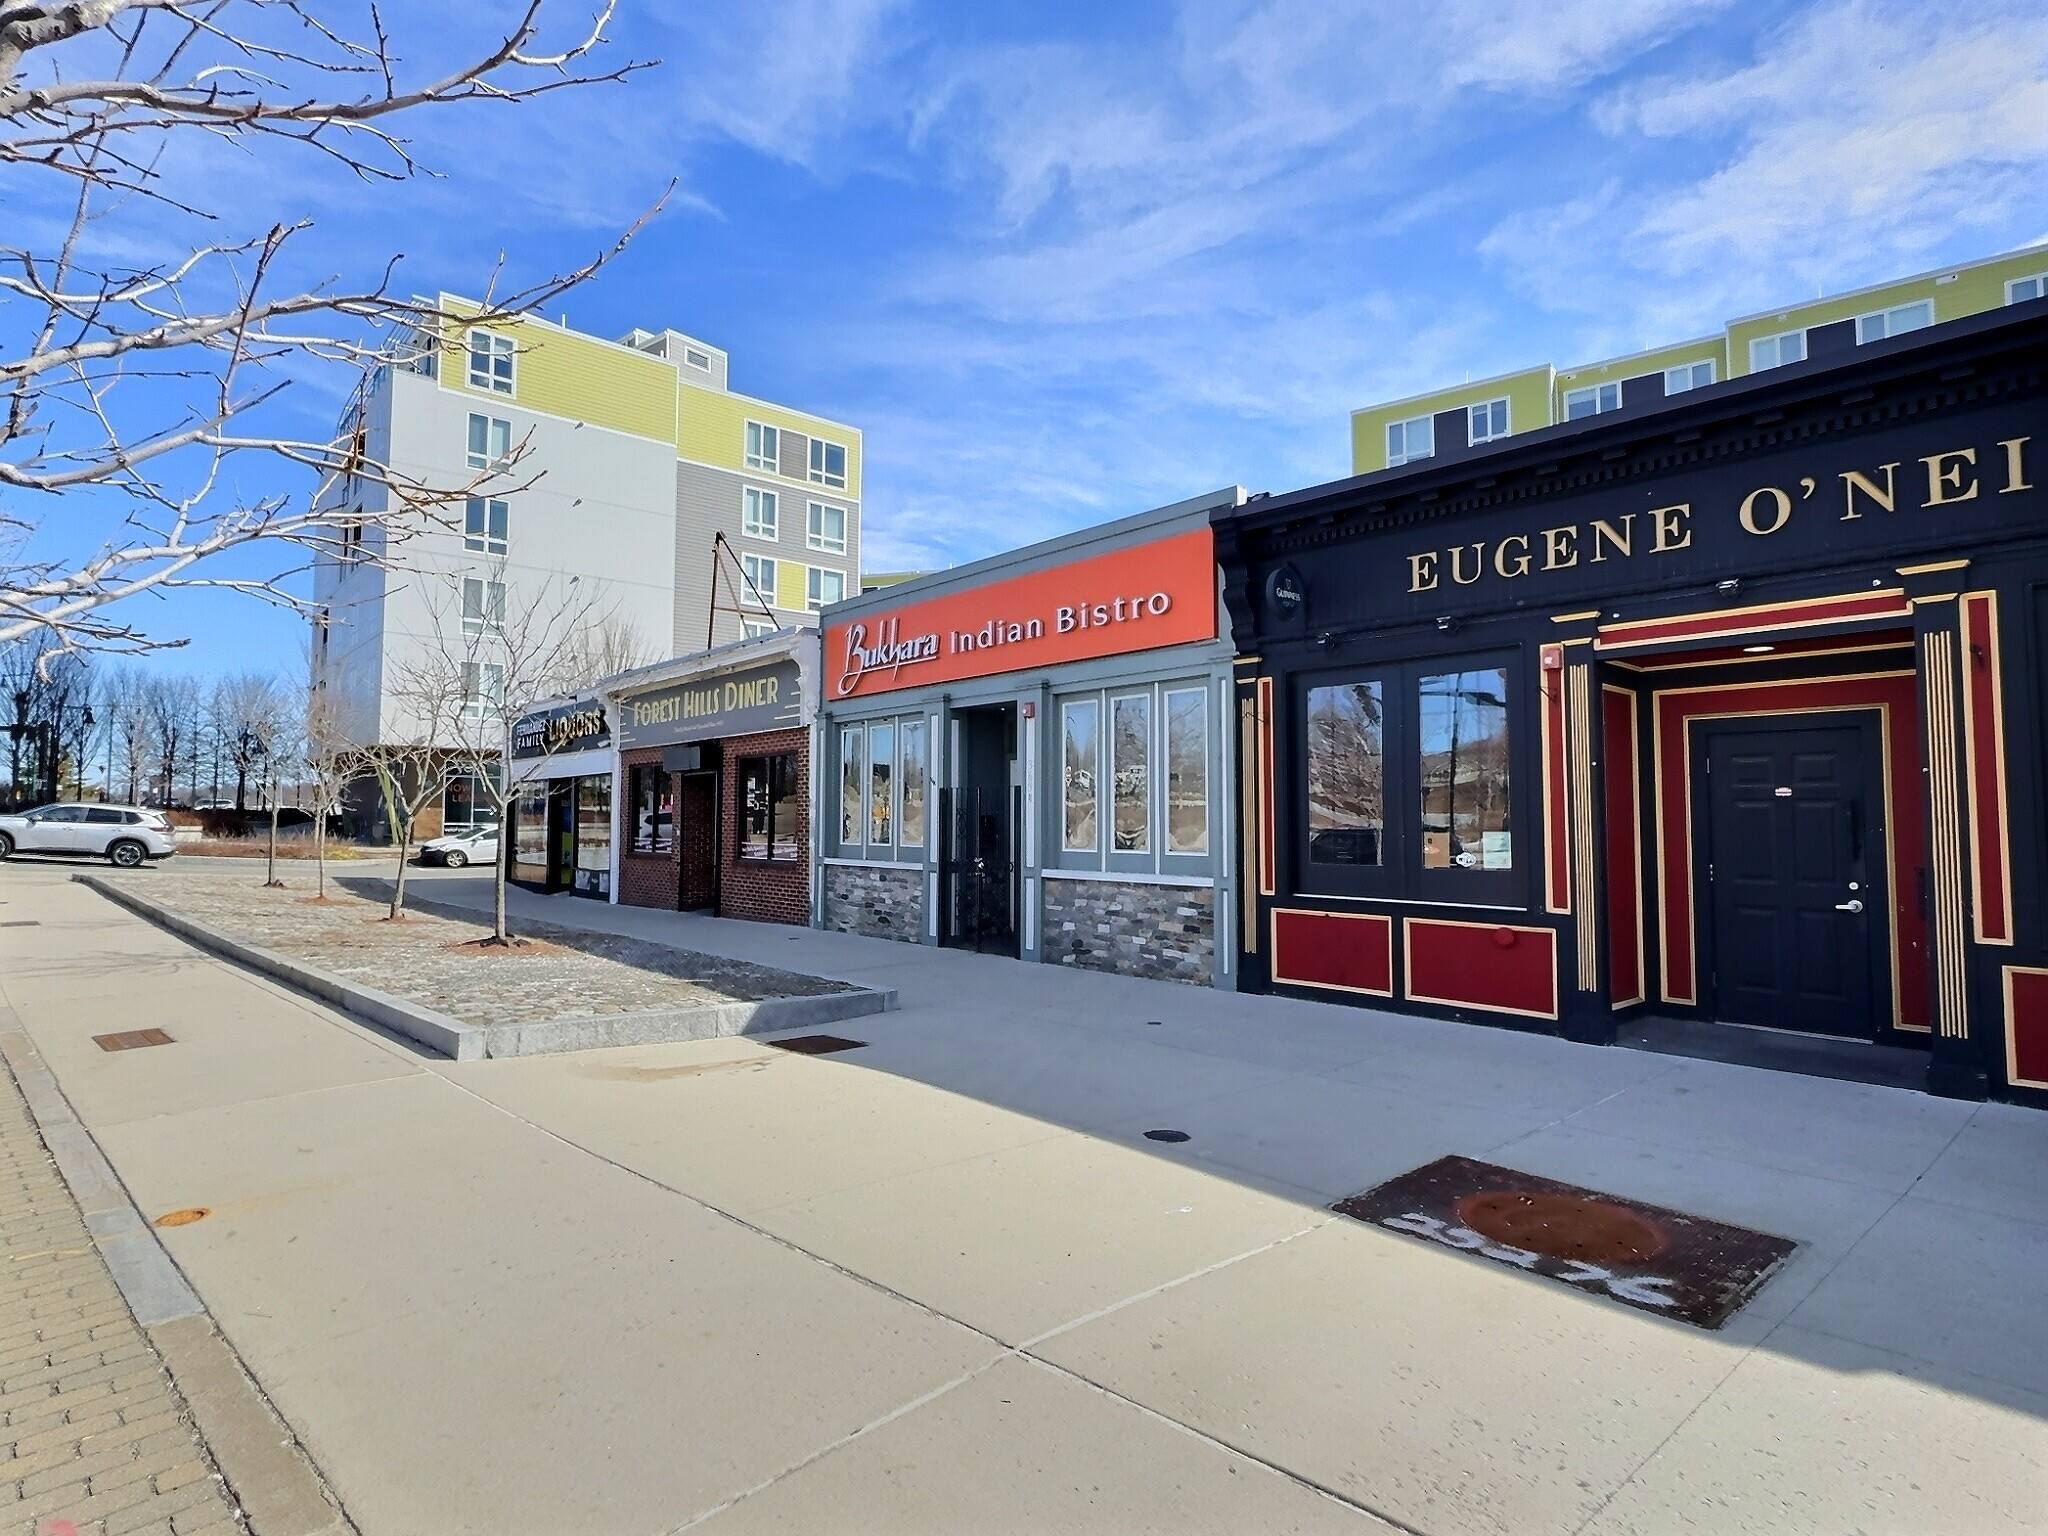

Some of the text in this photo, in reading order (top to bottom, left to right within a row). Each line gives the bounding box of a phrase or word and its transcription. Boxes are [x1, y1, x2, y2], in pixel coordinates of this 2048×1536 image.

[1406, 503, 1692, 593] EUGENE
[1276, 587, 1301, 602] GUINNESS
[838, 592, 1172, 696] Bukhara Indian Bistro
[633, 696, 681, 727] FOREST
[684, 687, 720, 719] HILLS
[724, 676, 779, 712] DINER
[516, 733, 545, 750] FAMILY
